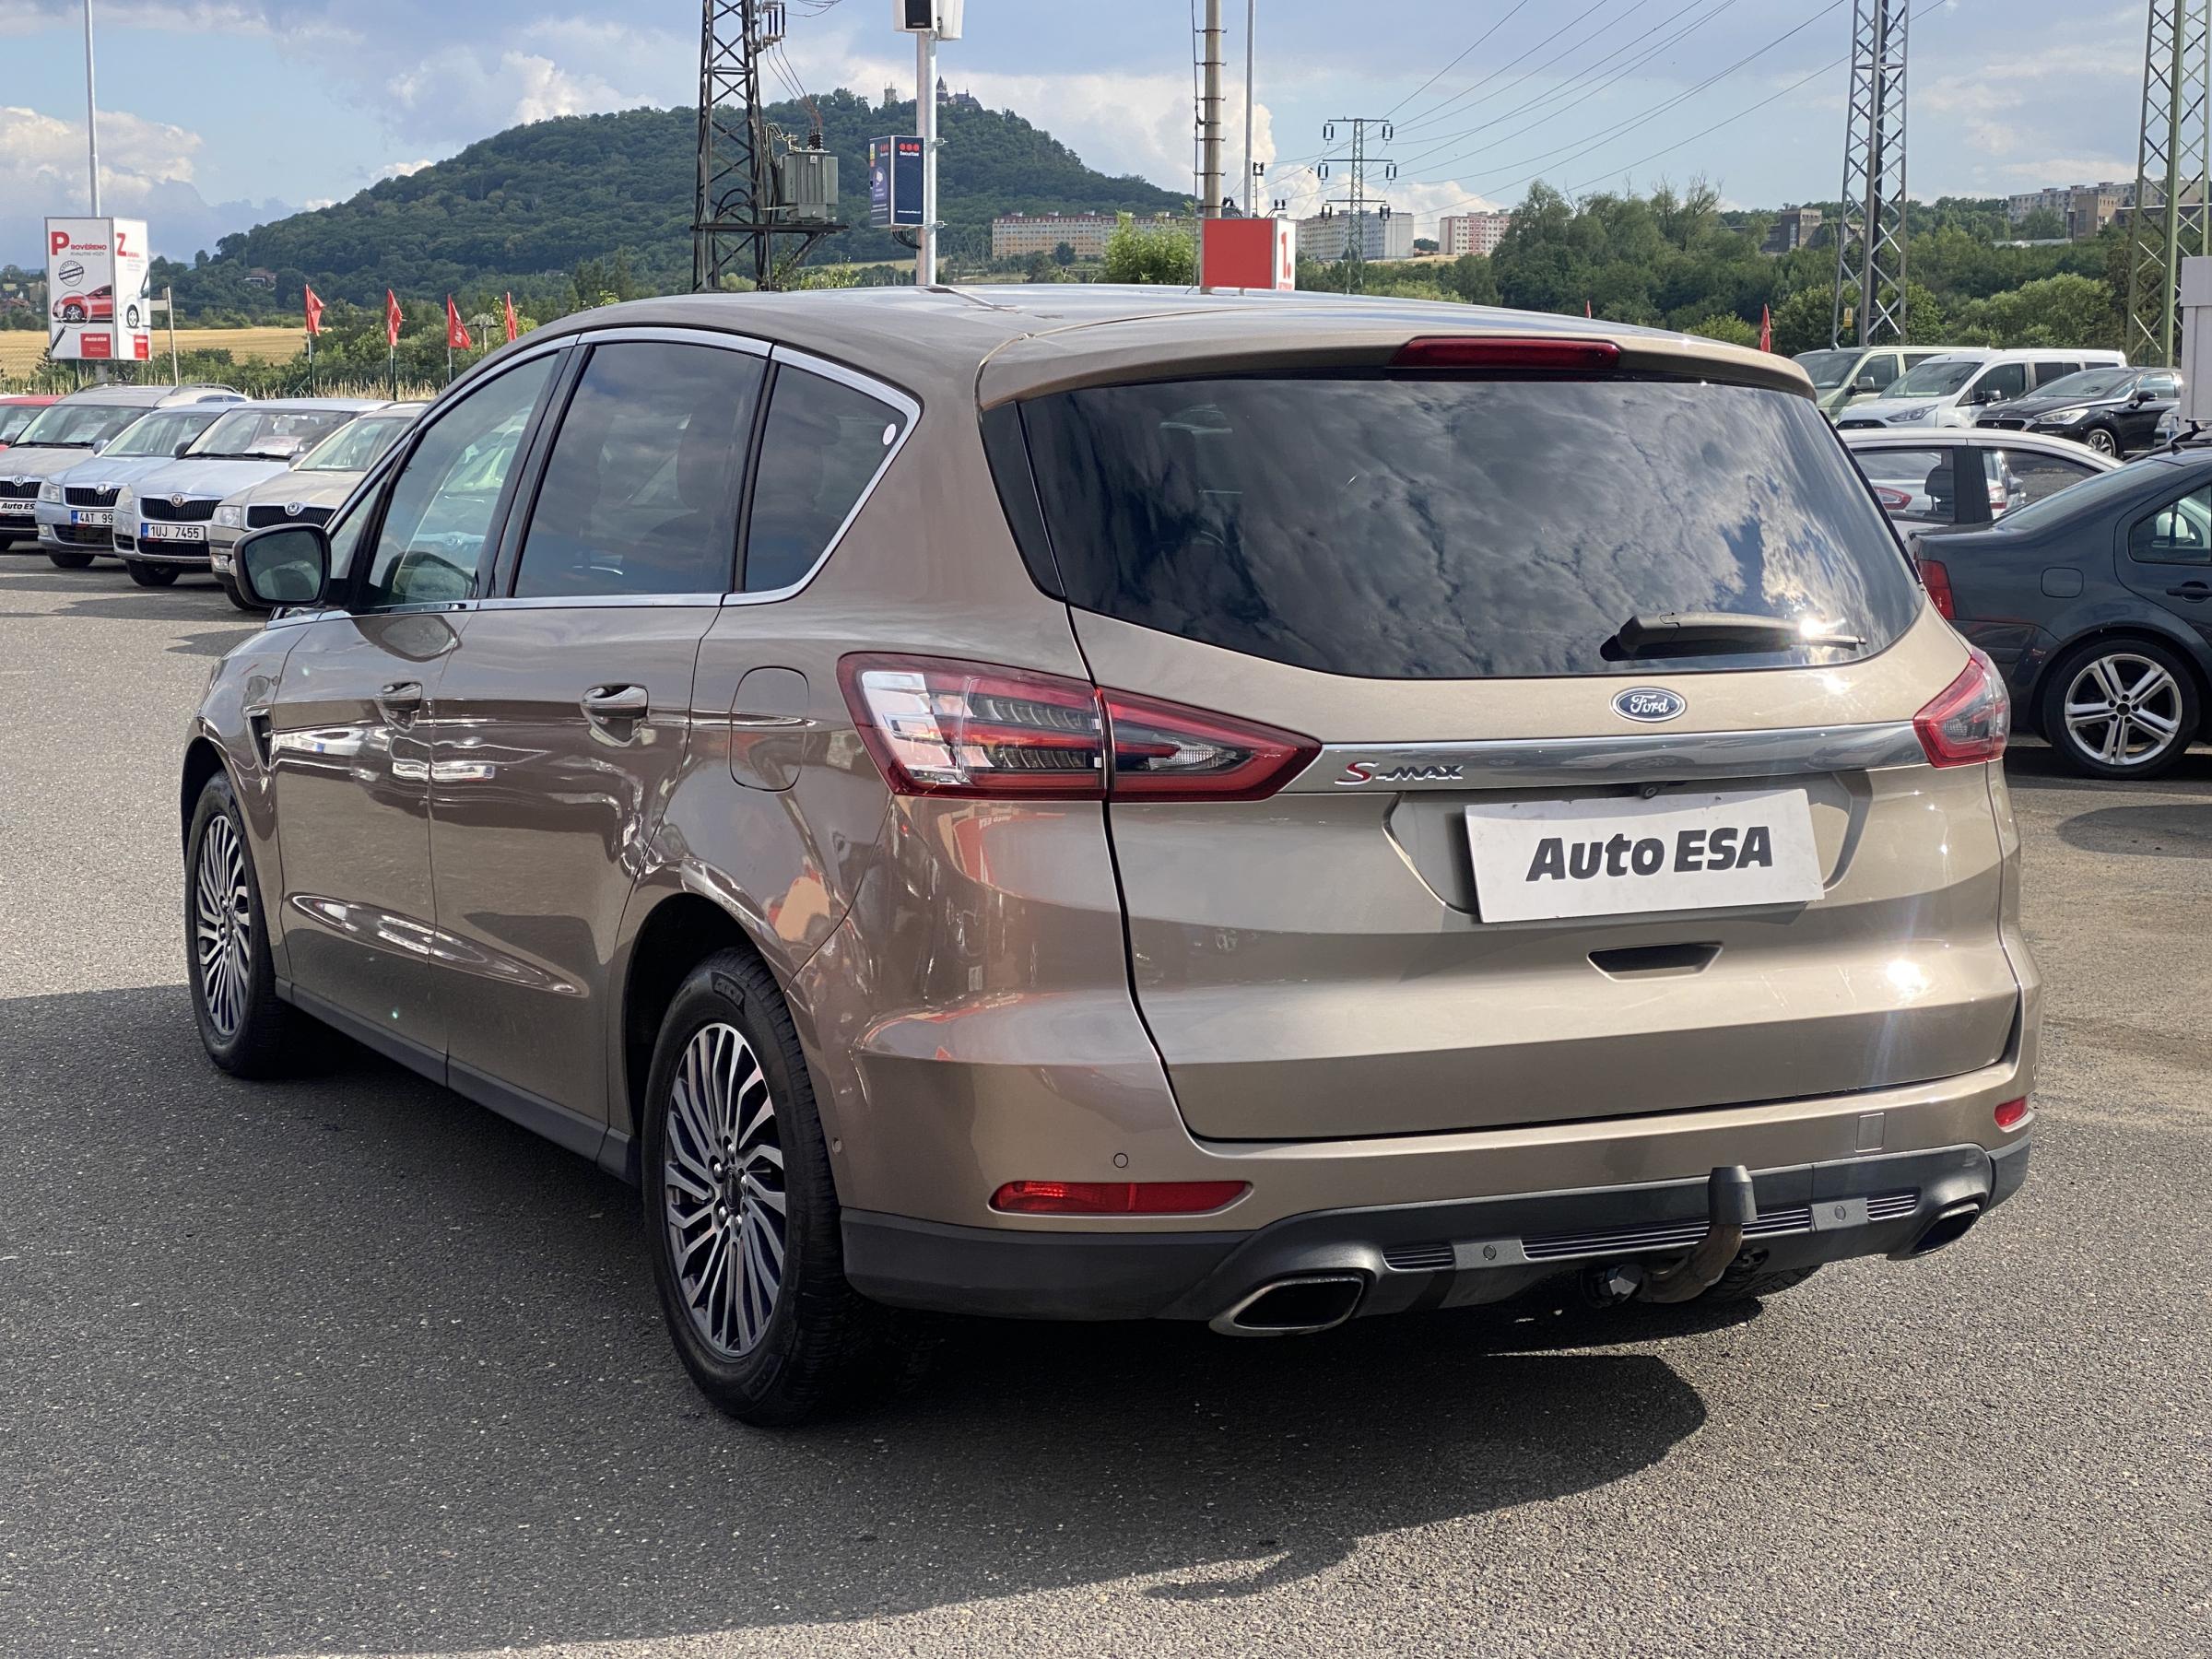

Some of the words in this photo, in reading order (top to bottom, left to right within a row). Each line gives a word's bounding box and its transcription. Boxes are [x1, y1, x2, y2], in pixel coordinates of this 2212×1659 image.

[2, 502, 23, 511] Auto
[79, 512, 94, 524] 4AT
[150, 526, 168, 537] 1UJ
[175, 527, 199, 539] 7455
[1630, 694, 1670, 713] Ford
[1335, 761, 1464, 785] S-MAX
[1525, 833, 1665, 882] Auto
[1673, 826, 1773, 873] ESA
